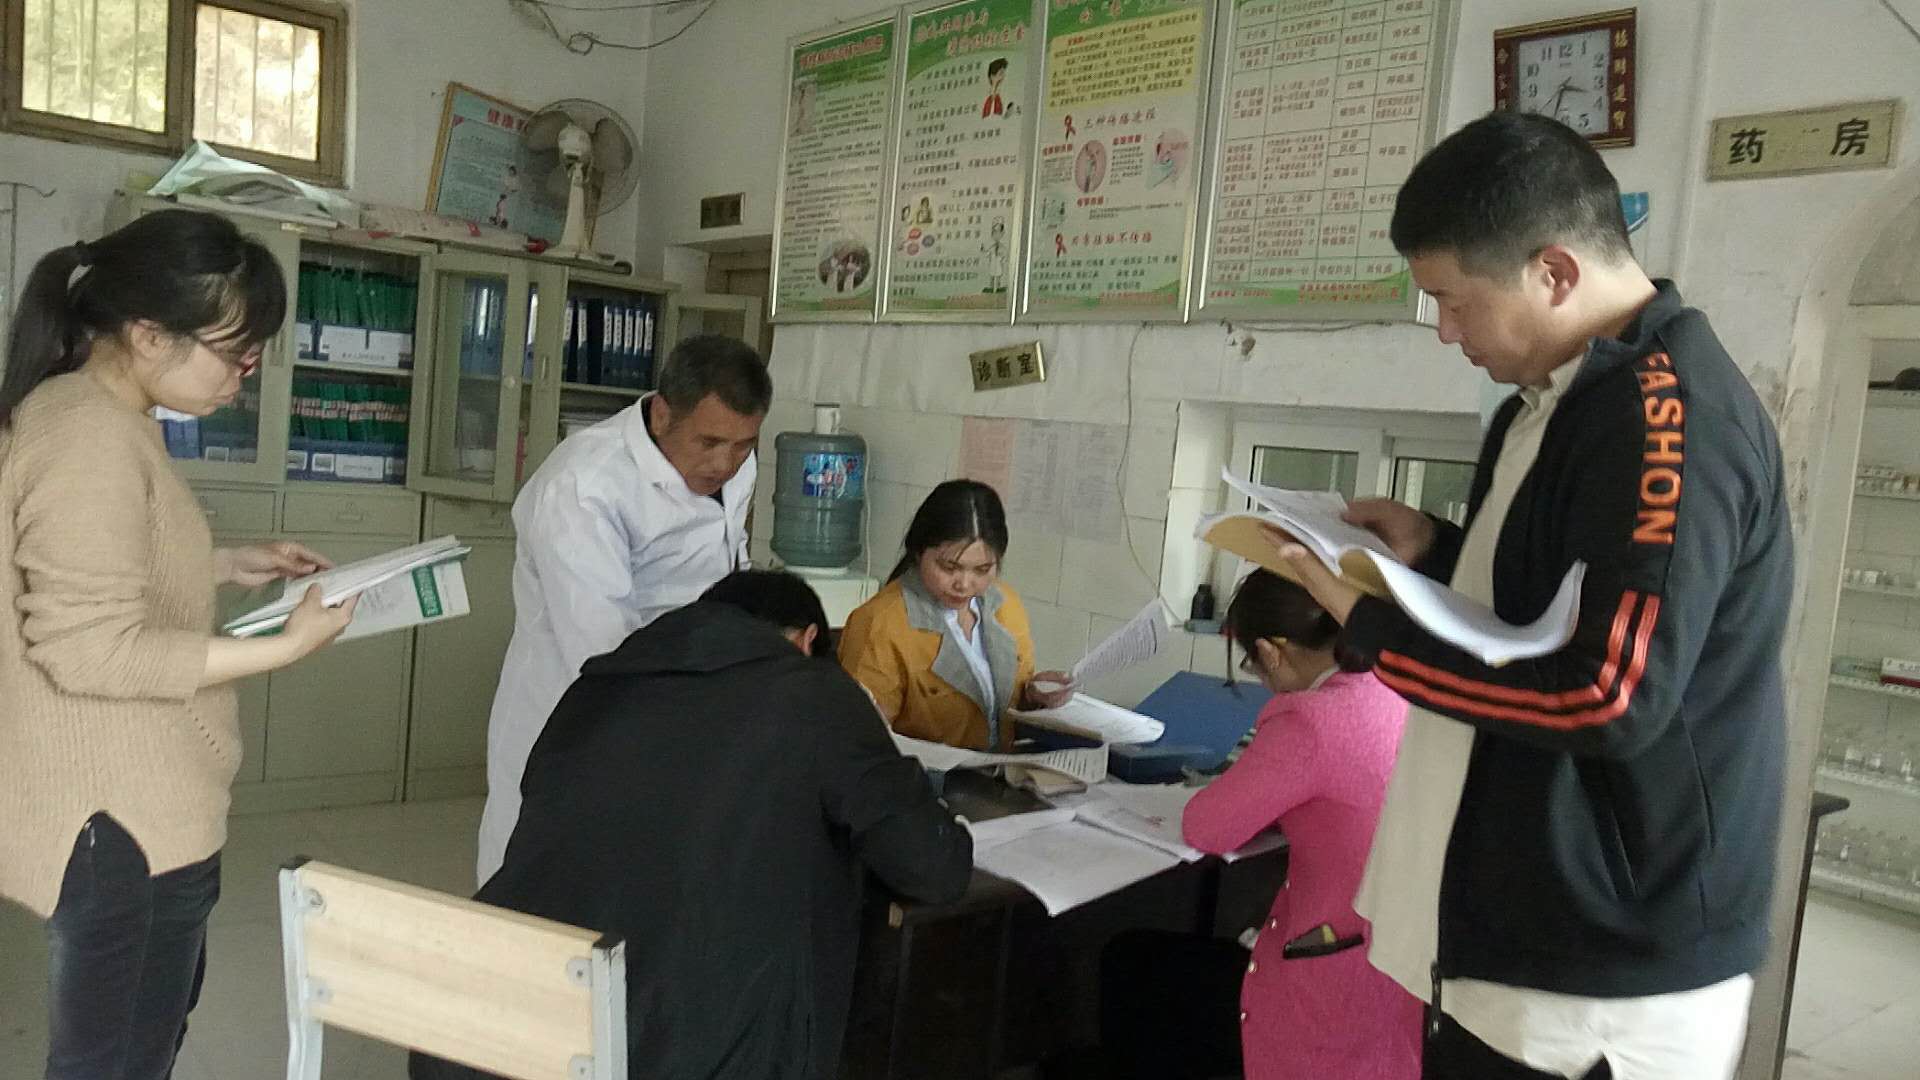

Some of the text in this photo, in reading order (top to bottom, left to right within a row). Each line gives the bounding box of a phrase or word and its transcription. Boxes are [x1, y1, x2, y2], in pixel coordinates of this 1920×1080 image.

[1541, 47, 1552, 61] 11
[1559, 44, 1573, 58] 12
[1728, 117, 1870, 164] 药房
[976, 352, 1034, 382] 诊断室
